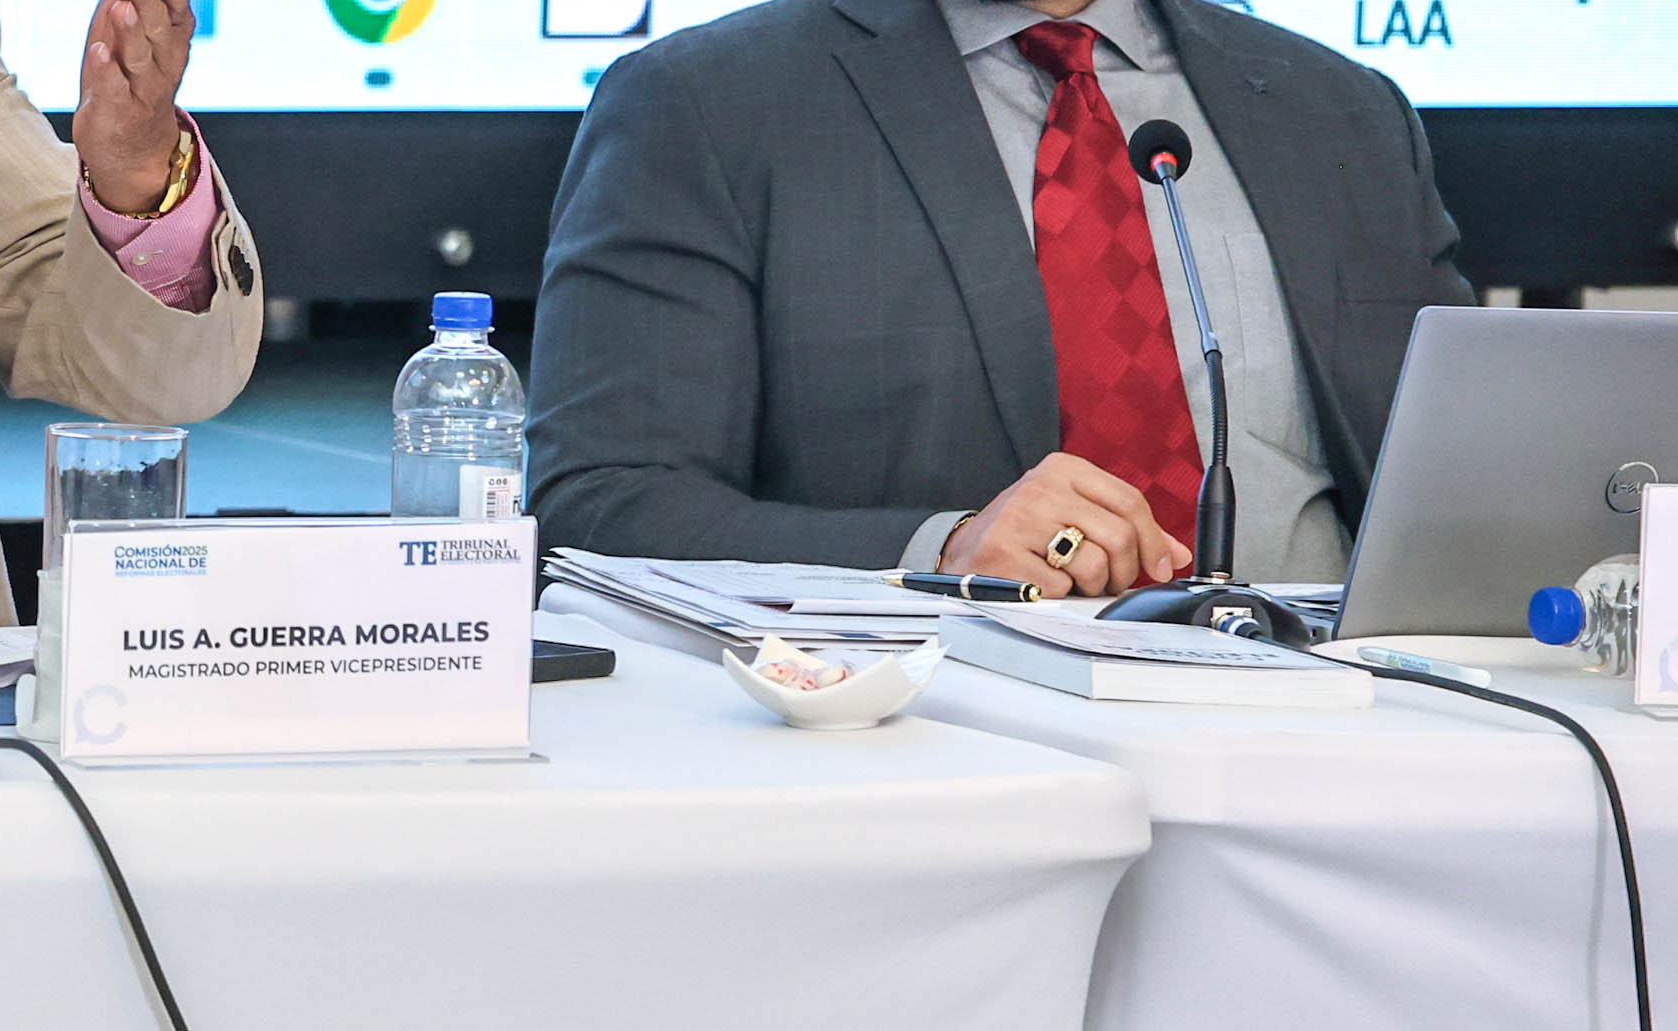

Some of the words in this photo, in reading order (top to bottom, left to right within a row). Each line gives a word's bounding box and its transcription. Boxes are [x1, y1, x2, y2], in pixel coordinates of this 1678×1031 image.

[399, 540, 437, 566] TE
[441, 539, 510, 549] TRIBUNAL
[115, 558, 185, 569] NACIONAL
[188, 556, 207, 569] DE
[441, 549, 521, 561] ELECTORAL
[123, 629, 185, 651] LUIS
[192, 628, 221, 650] A.
[229, 625, 347, 649] GUERRA
[355, 621, 490, 646] MORALES
[129, 661, 250, 679] MAGISTRADO
[255, 660, 325, 676] PRIMER
[330, 655, 482, 674] VICEPRESIDENTE
